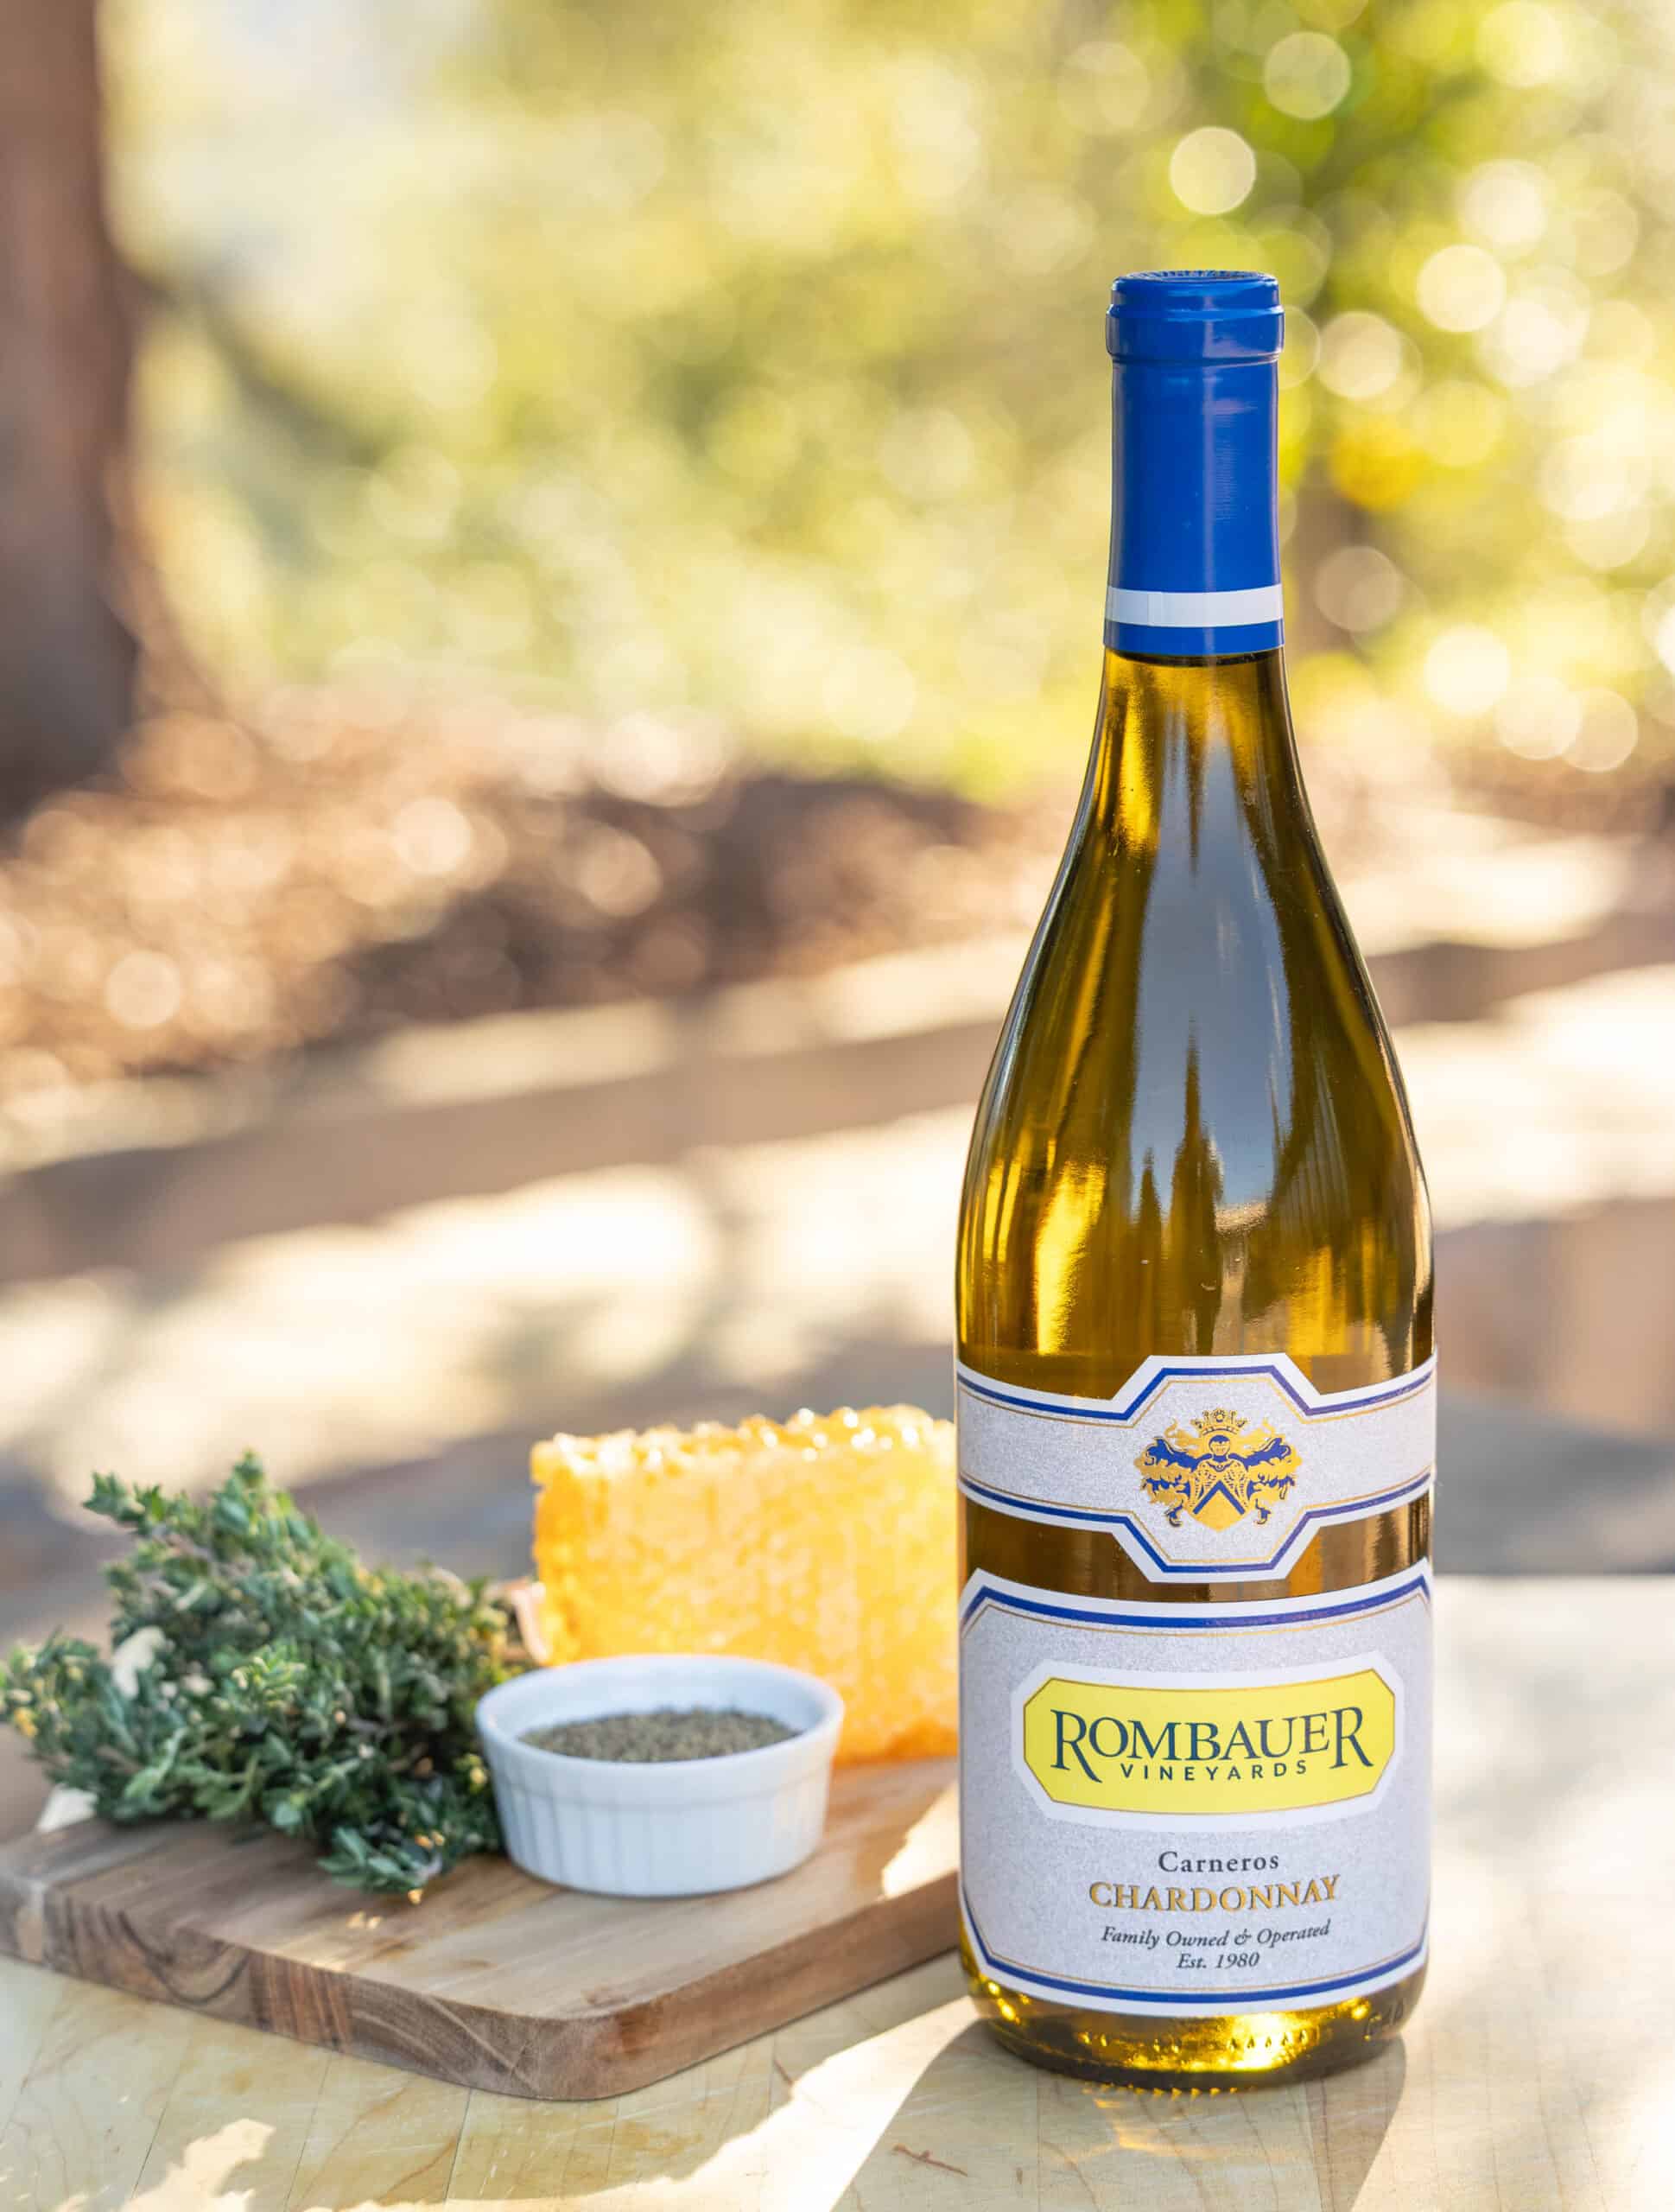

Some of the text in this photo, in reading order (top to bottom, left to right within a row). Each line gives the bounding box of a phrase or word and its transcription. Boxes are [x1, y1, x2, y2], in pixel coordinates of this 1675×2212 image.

[1050, 1706, 1374, 1783] ROMBAUER
[1120, 1759, 1307, 1781] VINEYARDS
[1158, 1851, 1279, 1873] Carneros
[1088, 1873, 1341, 1912] CHARDONNAY
[1101, 1918, 1331, 1949] Family Owned & Operated
[1176, 1951, 1260, 1969] Est. 1980
